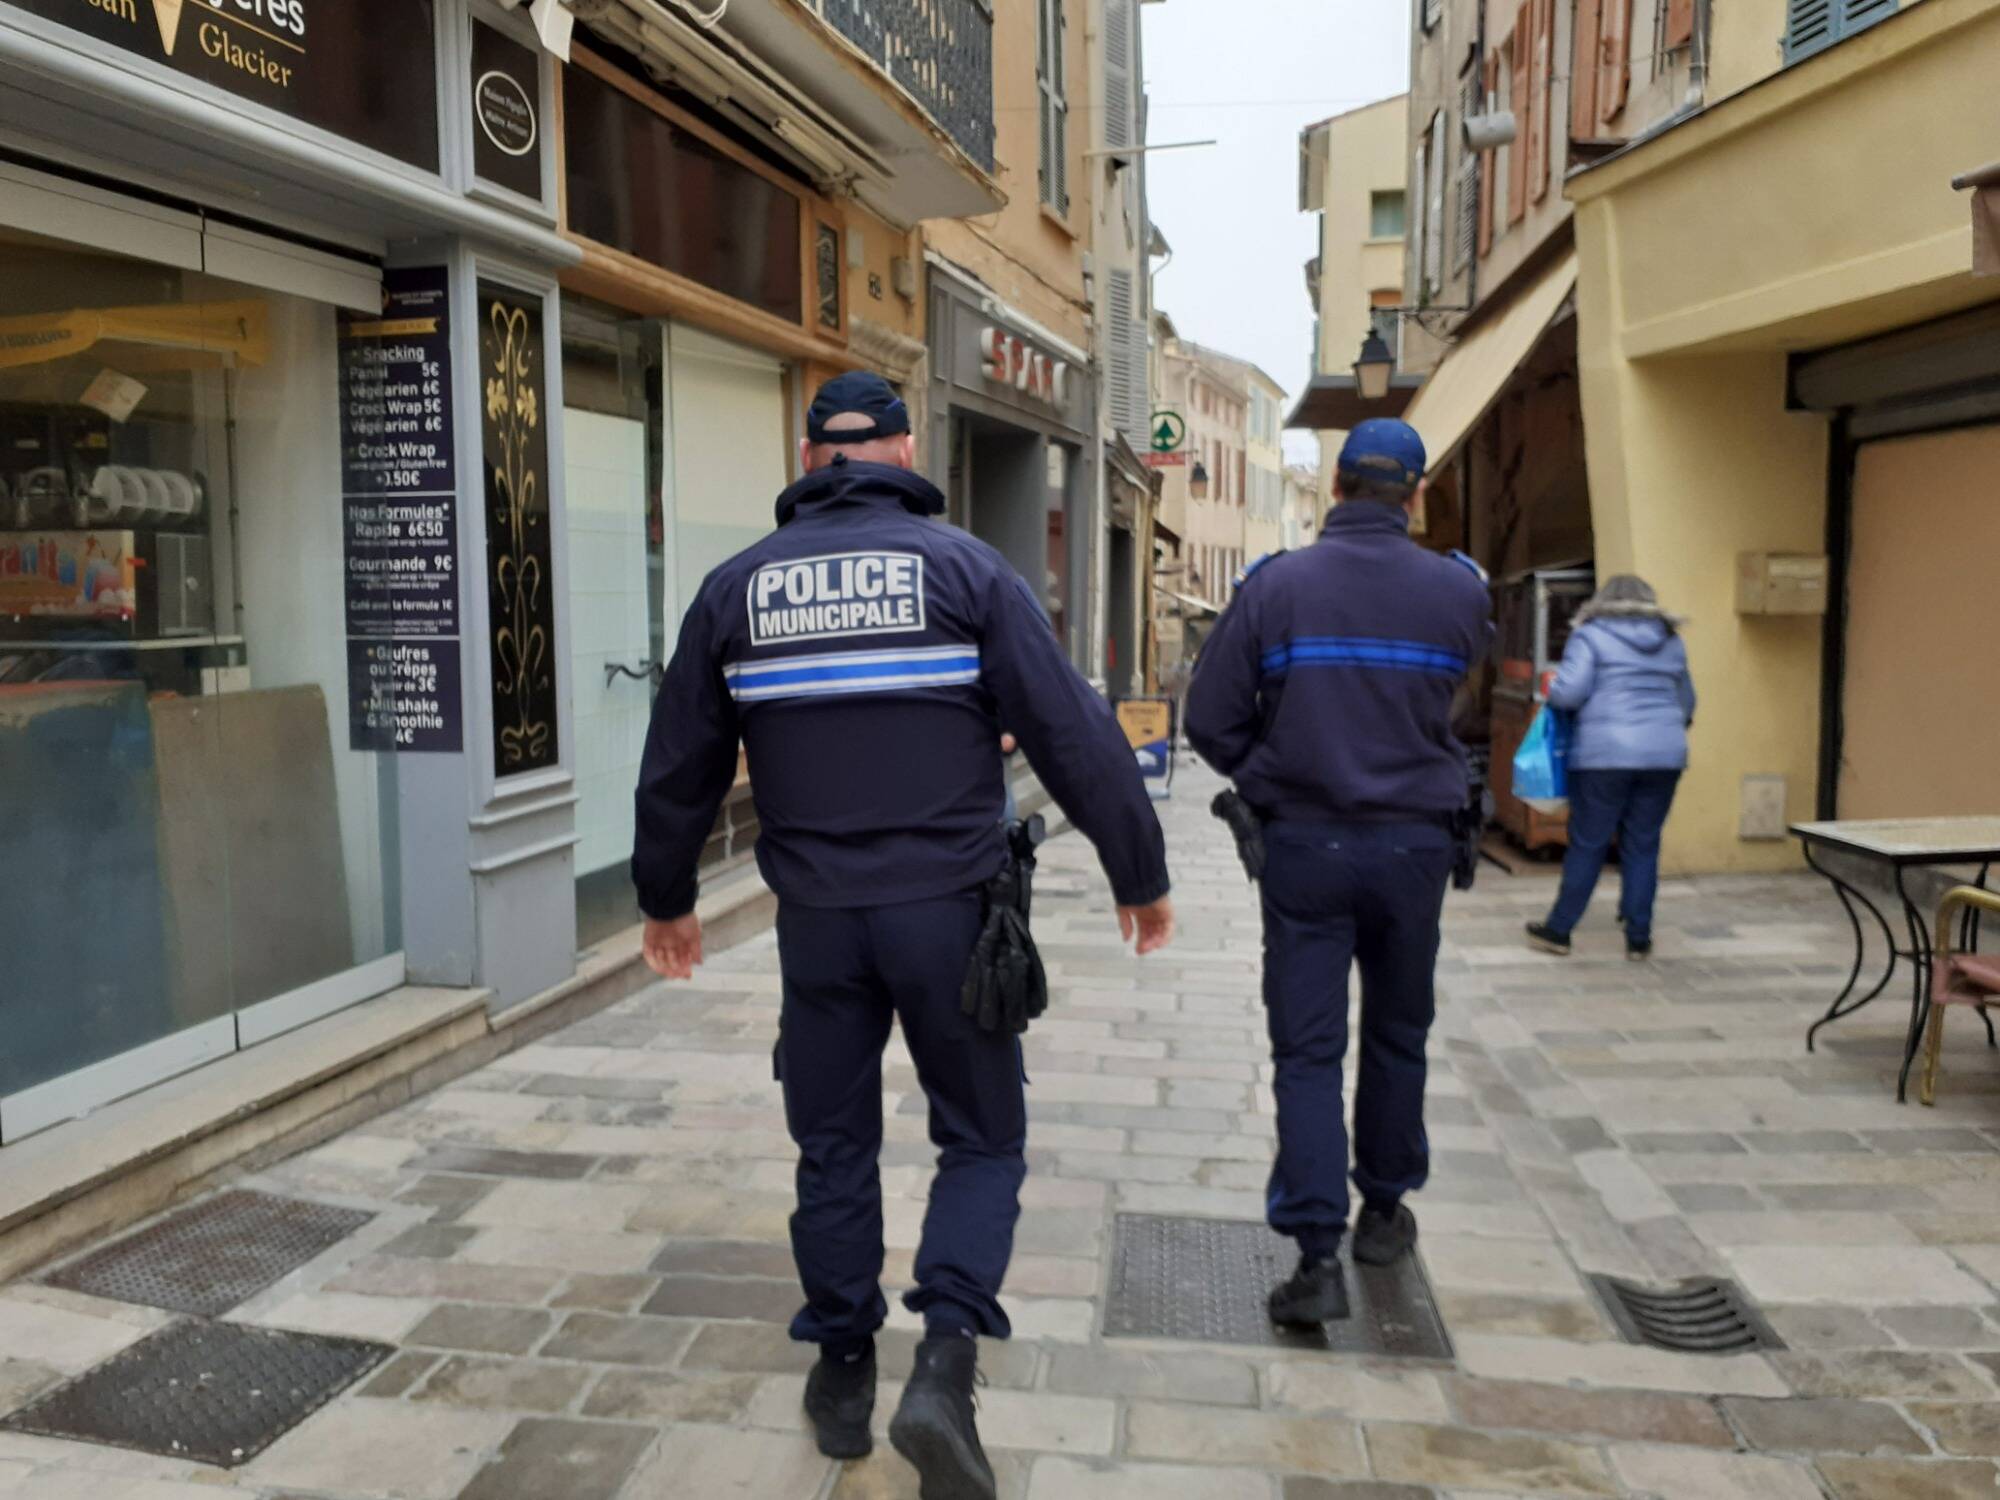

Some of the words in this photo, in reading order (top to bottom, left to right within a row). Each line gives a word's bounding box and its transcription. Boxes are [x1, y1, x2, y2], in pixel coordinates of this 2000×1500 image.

[199, 22, 293, 87] Glacier
[363, 345, 425, 363] Snacking
[422, 361, 440, 378] 5€
[422, 379, 440, 396] 6€
[387, 400, 423, 416] Wrap
[424, 397, 442, 414] 5€
[425, 416, 442, 432] 6€
[398, 441, 437, 460] Wrap
[349, 505, 376, 520] Nos
[408, 521, 444, 538] 6€50
[349, 556, 427, 572] Gourmande
[434, 554, 453, 572] 9€
[756, 558, 913, 608] POLICE
[402, 599, 440, 611] formule
[442, 599, 453, 611] 1€
[759, 598, 915, 638] MUNICIPALE
[369, 663, 387, 676] ou
[418, 676, 437, 692] 3€
[395, 727, 415, 744] 4€
